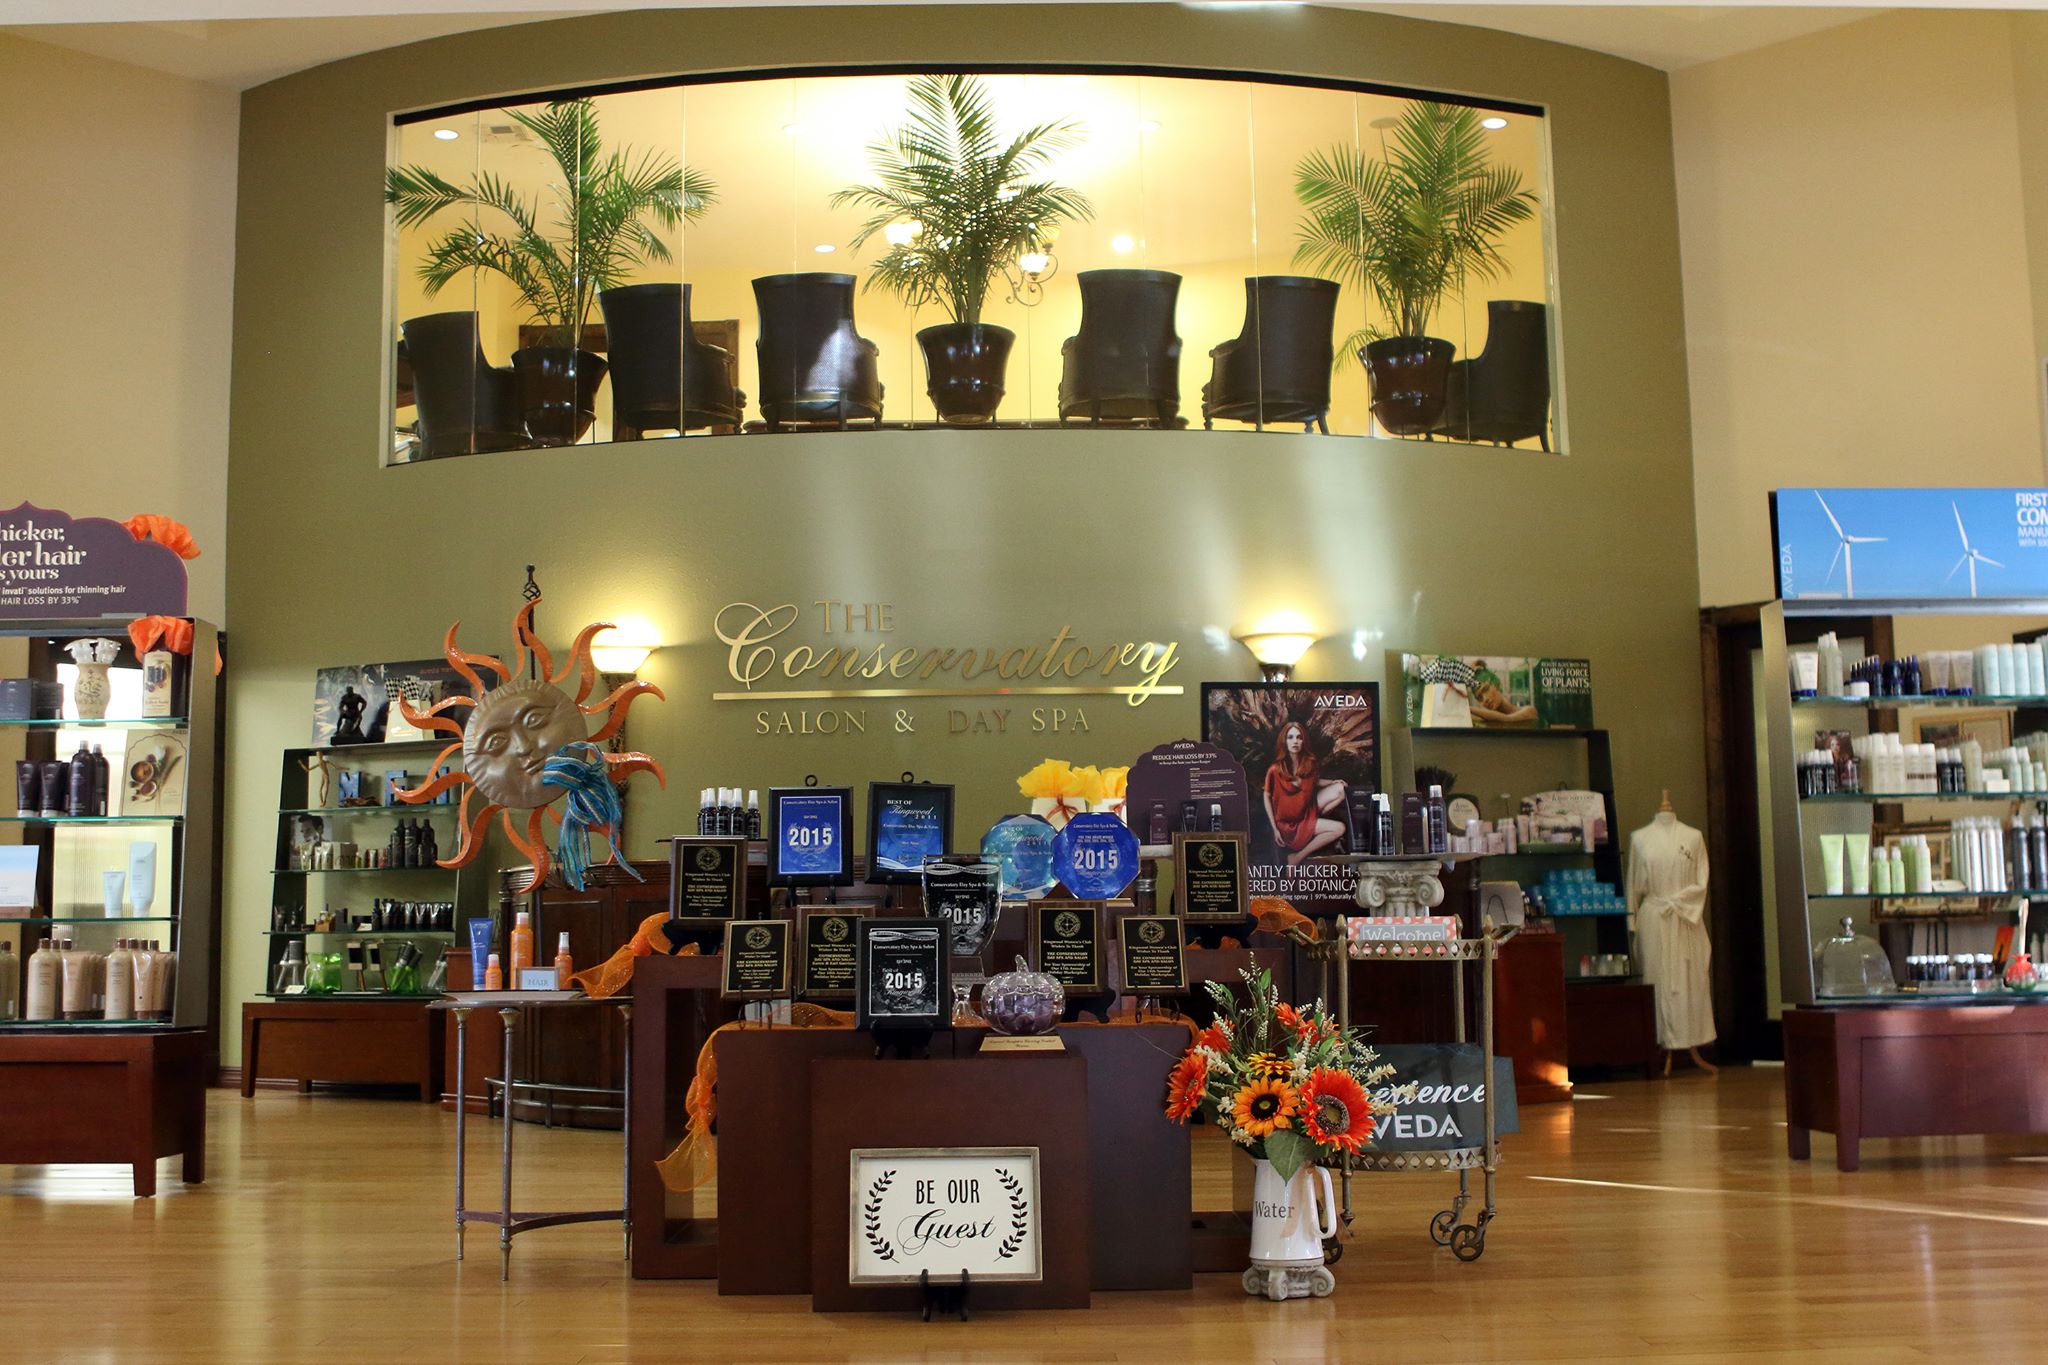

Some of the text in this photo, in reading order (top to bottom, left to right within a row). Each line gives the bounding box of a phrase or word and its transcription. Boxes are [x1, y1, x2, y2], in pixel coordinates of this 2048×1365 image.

[2016, 493, 2048, 506] FIRST
[0, 542, 87, 566] er hair
[6, 569, 59, 585] yours
[1782, 544, 1792, 595] AVEDA
[28, 586, 62, 594] solutions
[65, 586, 75, 594] for
[78, 585, 109, 595] thinning
[110, 585, 126, 593] hair
[1, 596, 20, 604] HAIR
[24, 596, 45, 604] LOSS
[48, 596, 59, 604] BY
[814, 600, 896, 633] THE
[714, 602, 1180, 706] Conservatory
[1541, 668, 1589, 677] LIVING FORCE
[1542, 677, 1590, 688] OF PLANTS
[1314, 695, 1367, 706] AVEDA
[756, 710, 1090, 734] SALON & DAY SPA
[889, 805, 934, 818] Kingwood
[789, 828, 832, 846] 2015
[1074, 849, 1118, 870] 2015
[1286, 865, 1338, 878] THICKER
[1281, 880, 1296, 891] BY
[944, 907, 981, 924] 2015
[1366, 926, 1441, 940] Welcome
[885, 973, 923, 989] 2015
[1368, 1114, 1463, 1140] VEDA
[916, 1180, 980, 1204] BE OUR
[1255, 1201, 1295, 1218] Water
[896, 1208, 996, 1256] Guest
